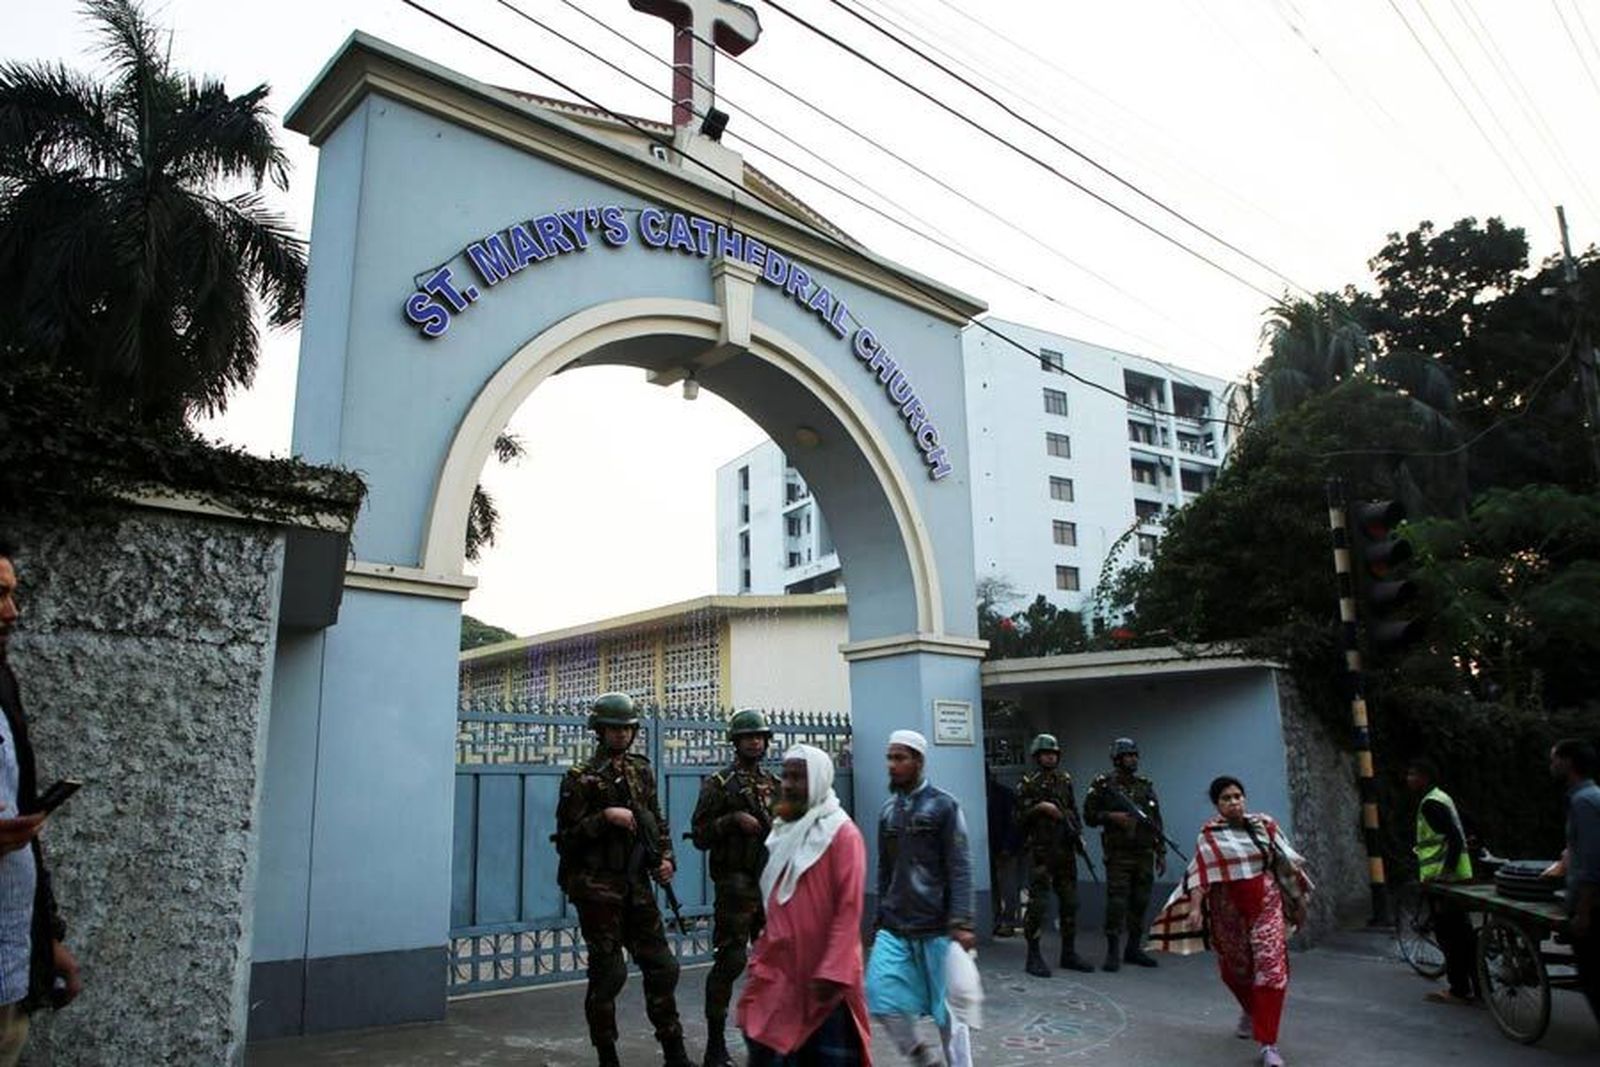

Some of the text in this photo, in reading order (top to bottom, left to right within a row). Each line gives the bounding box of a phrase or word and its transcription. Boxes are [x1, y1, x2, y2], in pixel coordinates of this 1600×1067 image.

[405, 205, 953, 479] ST. MARY'S CATHEDRAL CHURCH
